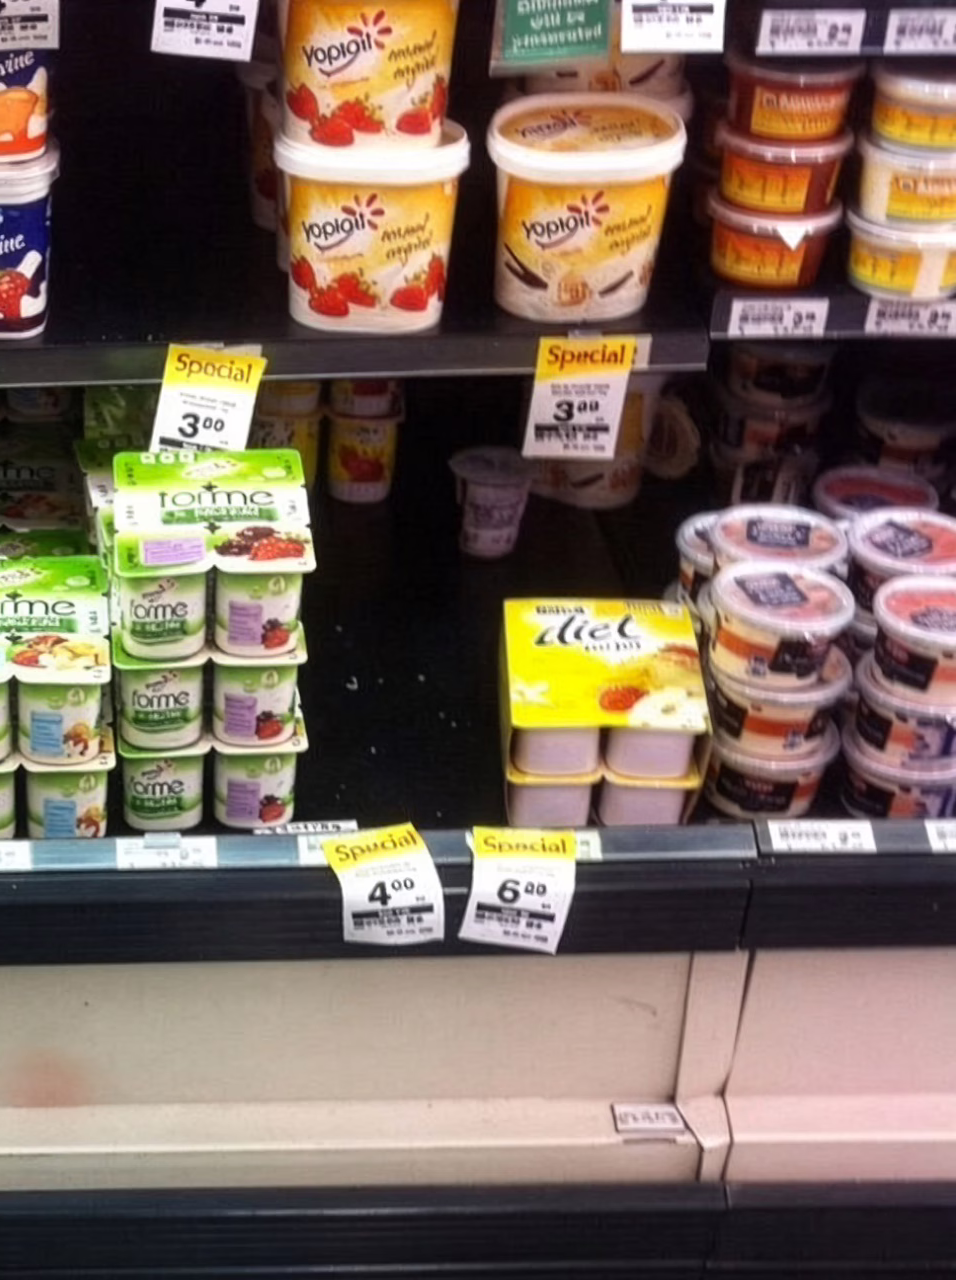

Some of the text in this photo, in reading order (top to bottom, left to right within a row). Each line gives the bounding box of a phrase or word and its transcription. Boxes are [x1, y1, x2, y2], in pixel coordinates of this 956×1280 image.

[175, 354, 253, 384] Special
[547, 344, 625, 371] Special
[335, 829, 419, 862] Special
[483, 836, 567, 854] Special
